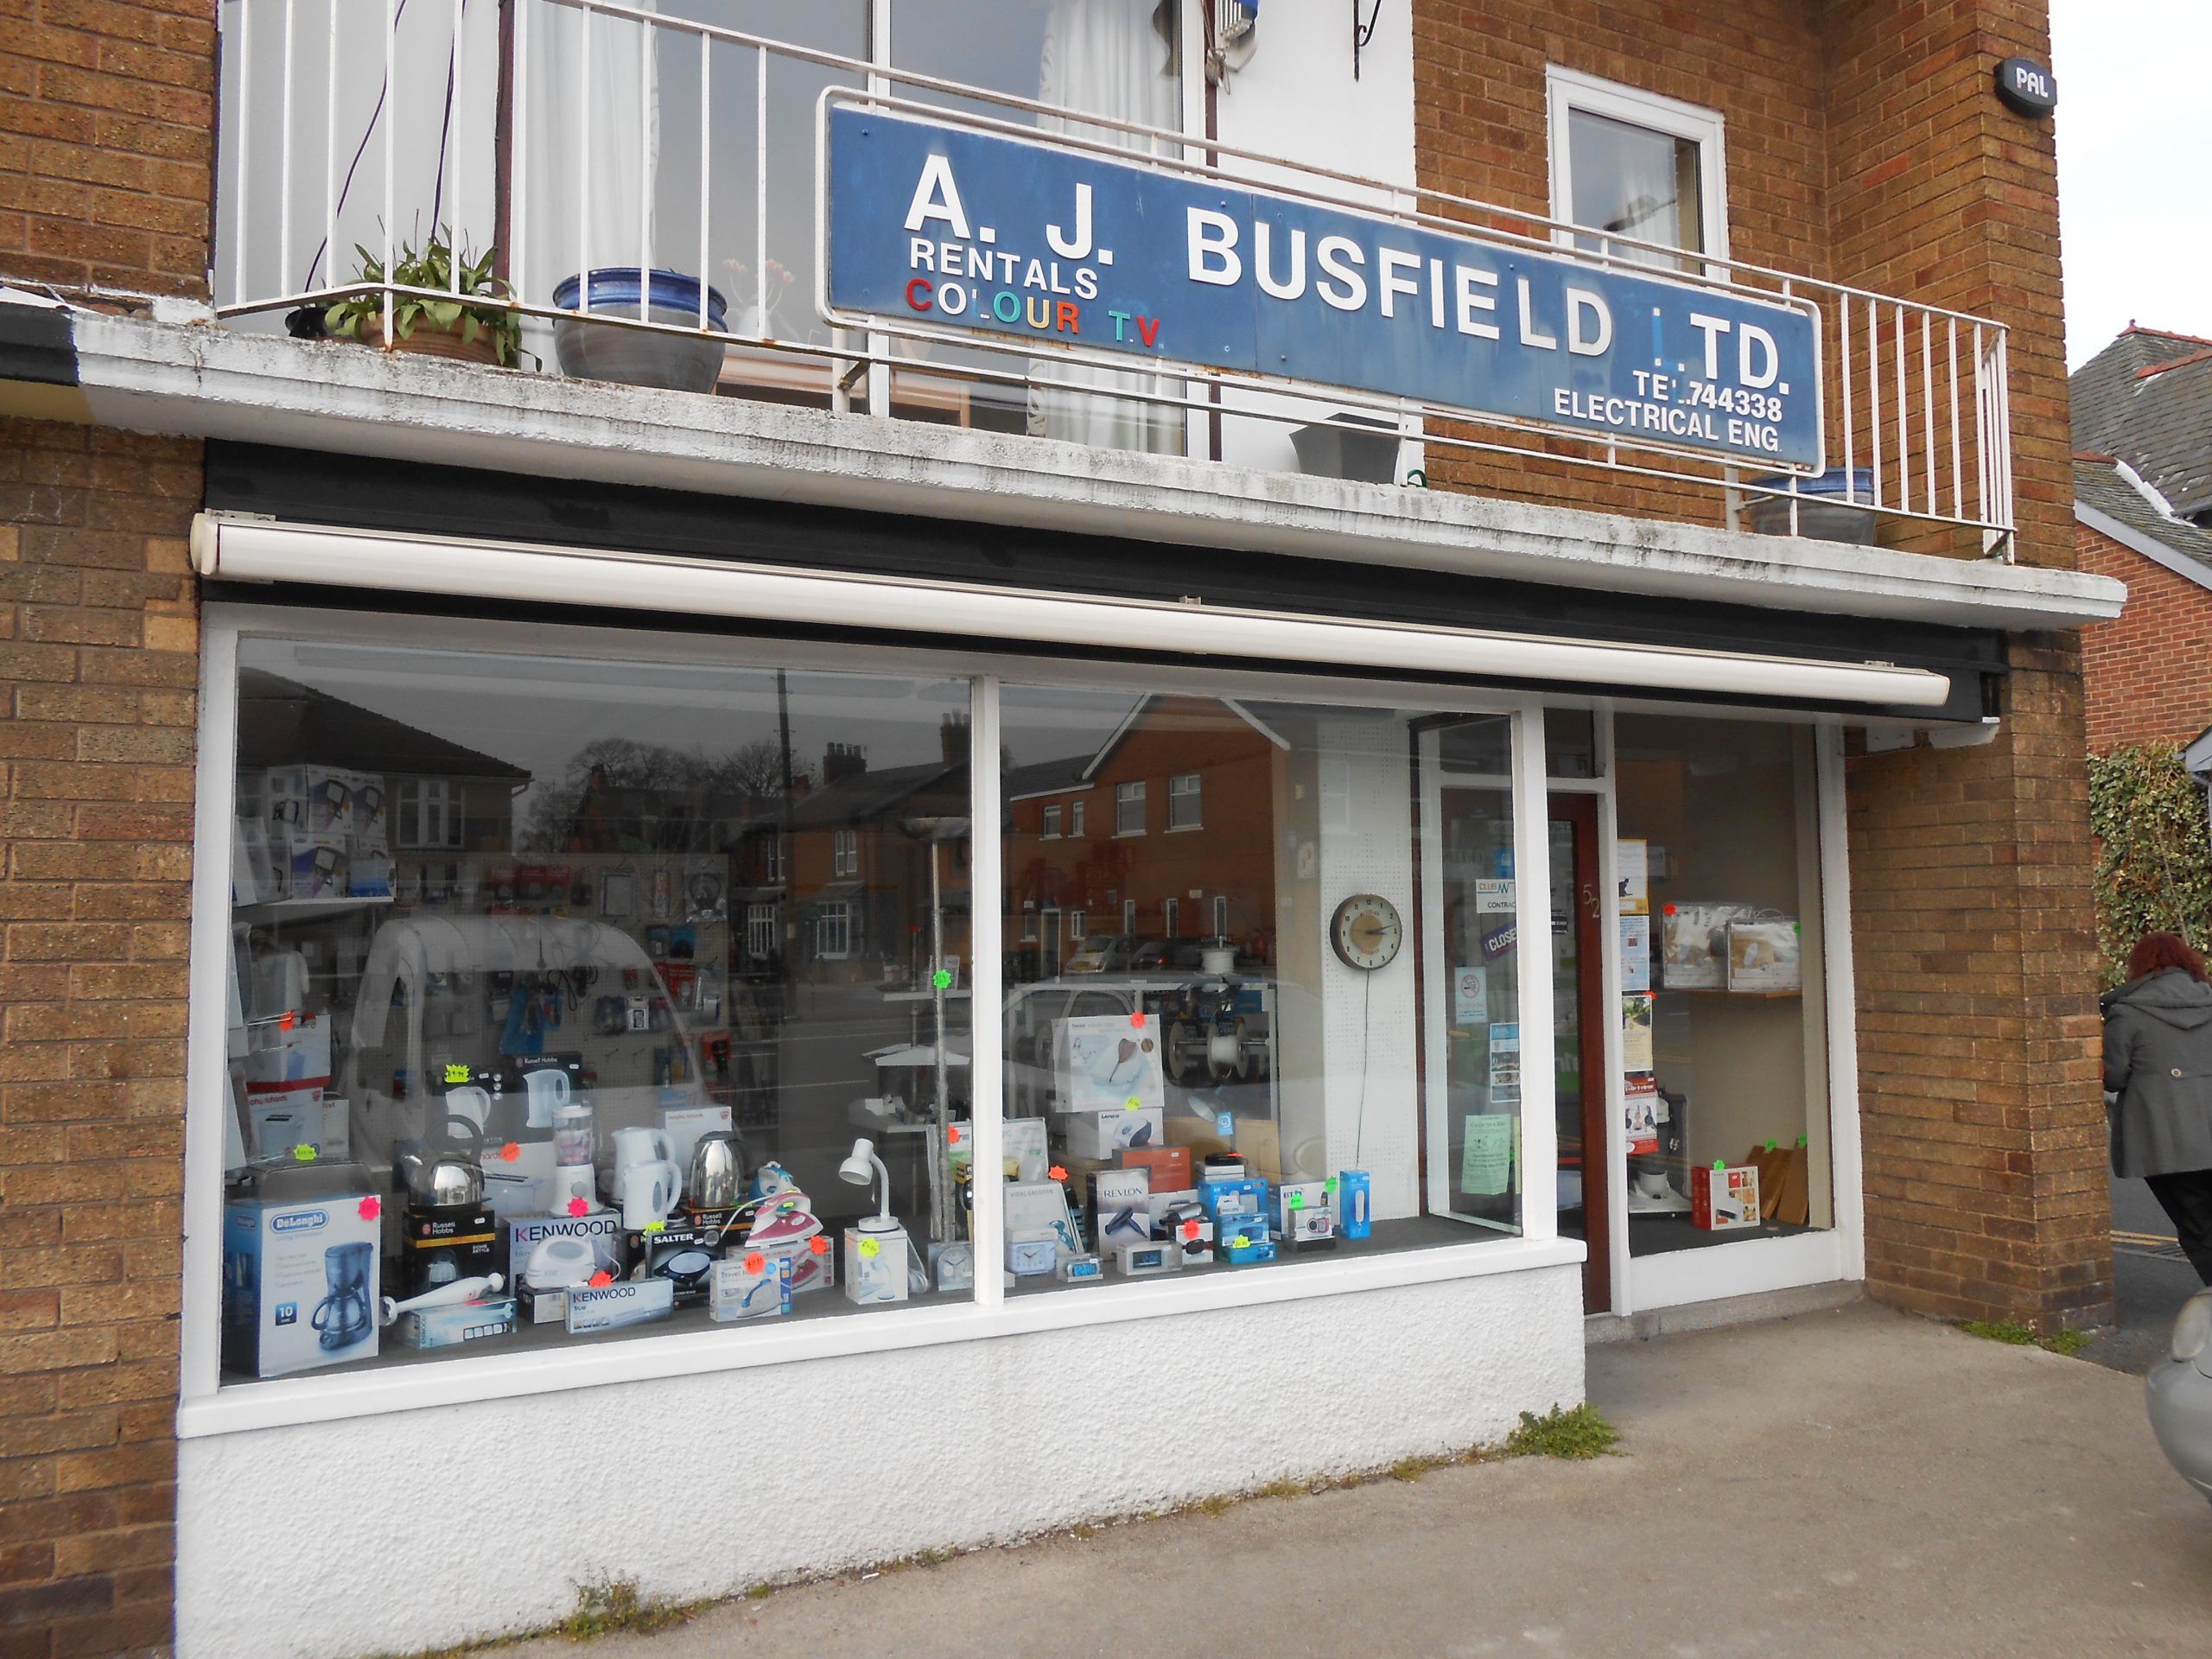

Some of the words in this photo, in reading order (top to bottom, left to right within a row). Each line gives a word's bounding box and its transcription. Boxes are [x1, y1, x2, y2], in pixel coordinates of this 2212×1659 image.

[2016, 67, 2049, 98] PAL
[910, 238, 1098, 301] RENTALS
[1186, 206, 1613, 357] BUSFIELD
[1554, 388, 1719, 441] ELECTRICAL
[1479, 882, 1497, 891] CLUB
[1488, 927, 1517, 951] CLOSE
[1103, 1187, 1143, 1198] REVLON
[515, 1219, 617, 1243] KENWOOD
[653, 1233, 694, 1244] SALTER
[573, 1287, 636, 1303] KENWOOD
[279, 1307, 293, 1318] 10
